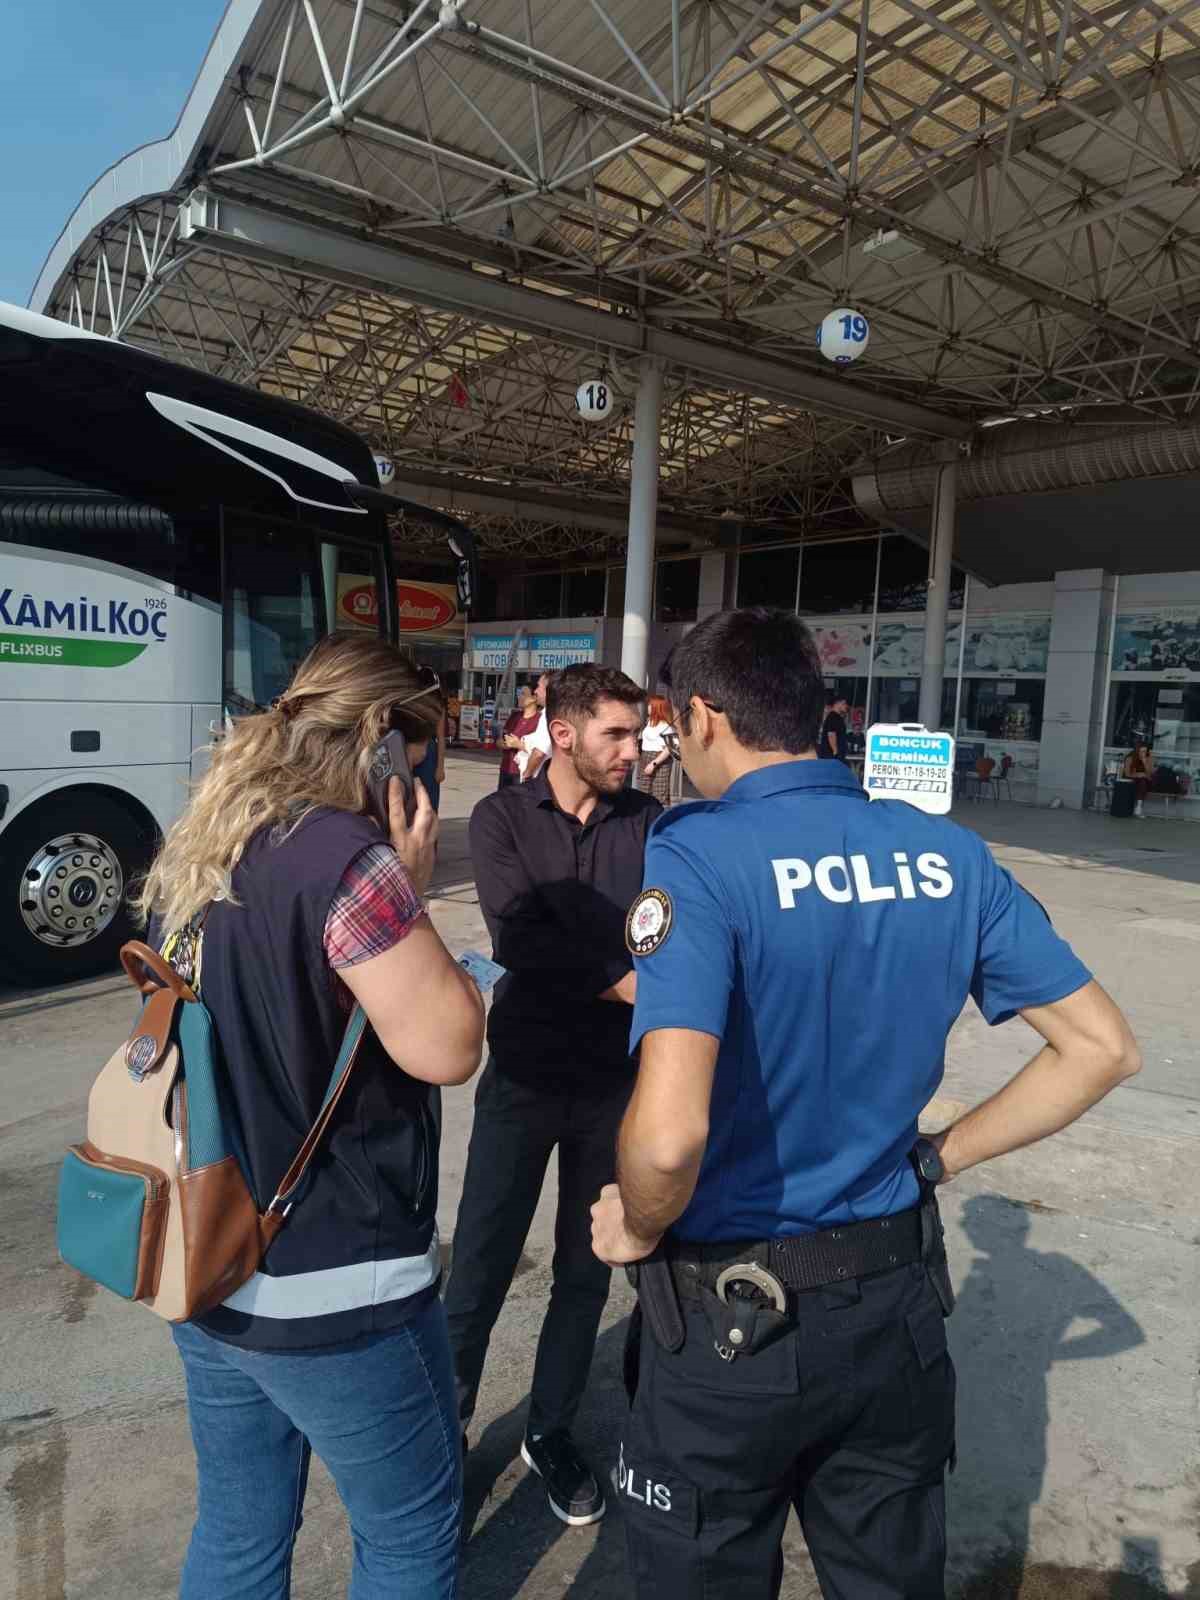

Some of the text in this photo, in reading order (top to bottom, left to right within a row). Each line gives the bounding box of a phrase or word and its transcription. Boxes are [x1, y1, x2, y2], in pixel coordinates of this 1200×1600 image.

[838, 315, 867, 342] 19
[586, 384, 607, 410] 18
[378, 463, 394, 476] 17
[144, 598, 167, 609] 1926
[483, 653, 520, 666] OTOBS
[879, 737, 943, 750] BONCUK
